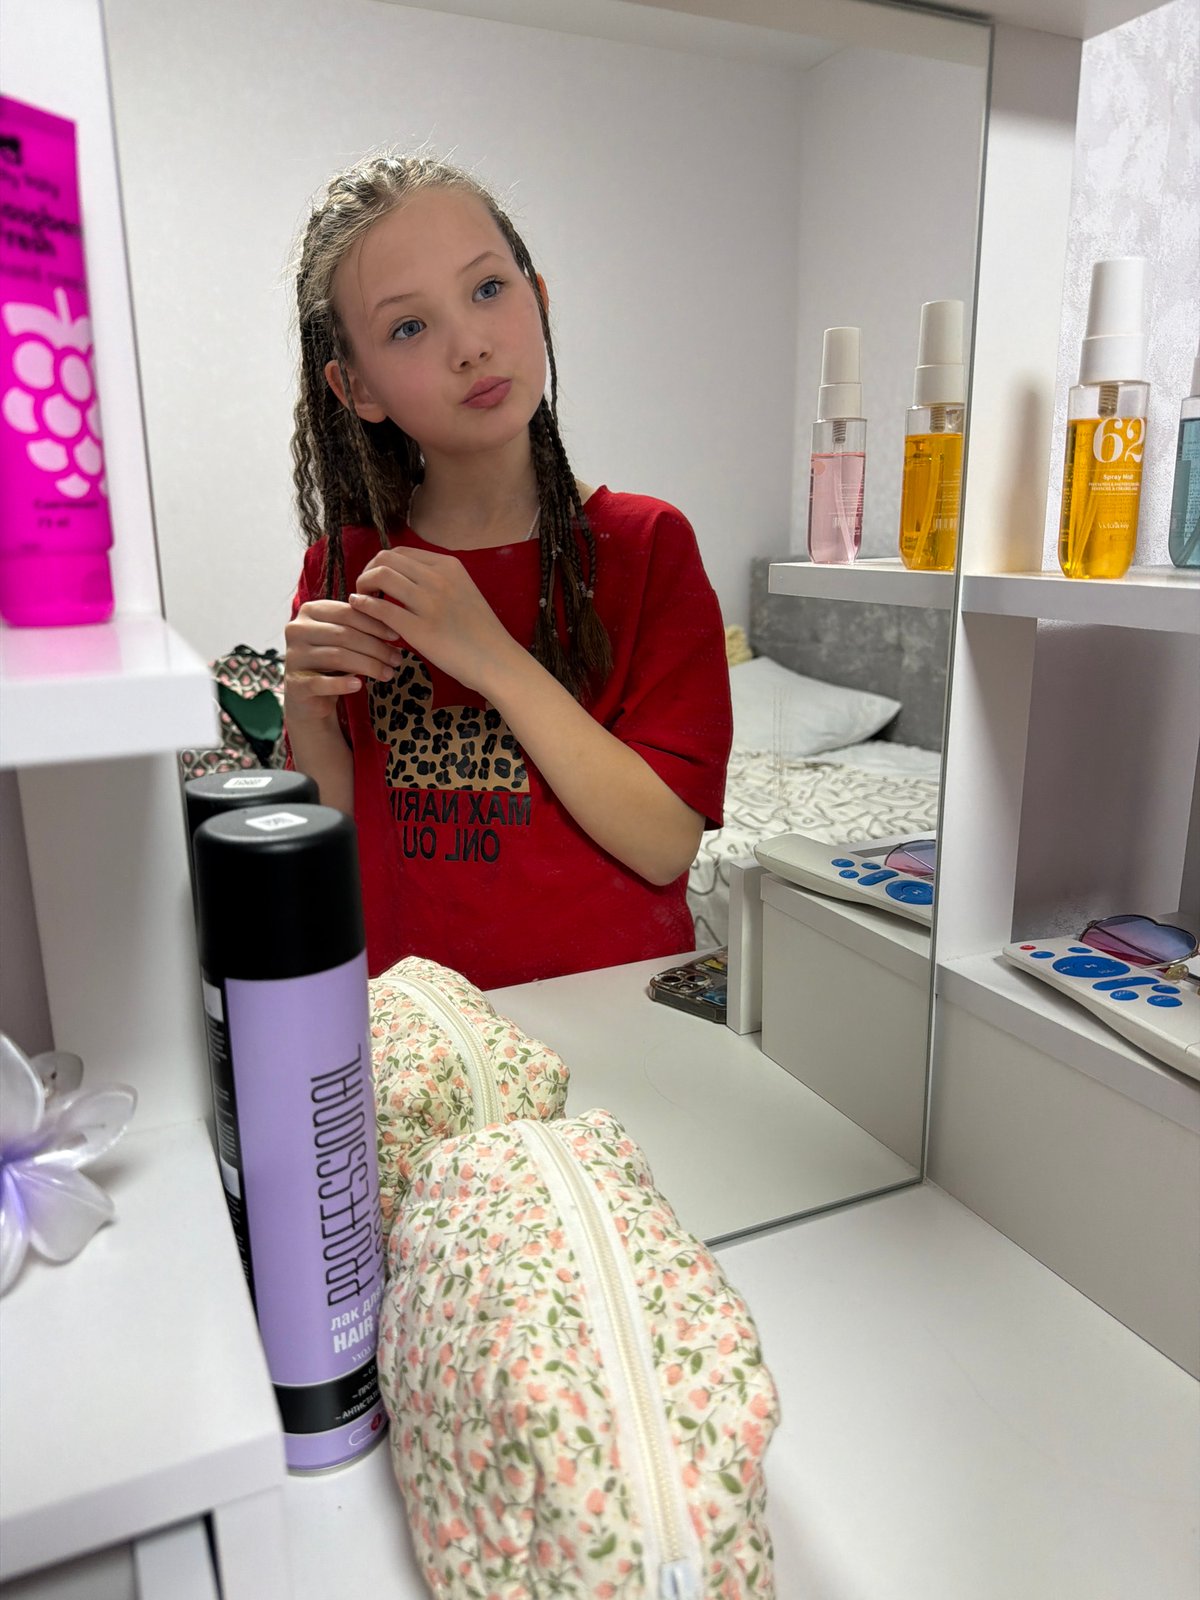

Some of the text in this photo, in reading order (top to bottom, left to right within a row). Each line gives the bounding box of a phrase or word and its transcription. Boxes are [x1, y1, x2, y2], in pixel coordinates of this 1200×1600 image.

[1093, 417, 1145, 463] 62
[310, 1043, 375, 1306] PROFESSIONAL
[330, 1307, 360, 1331] лак
[333, 1314, 374, 1354] HAIR
